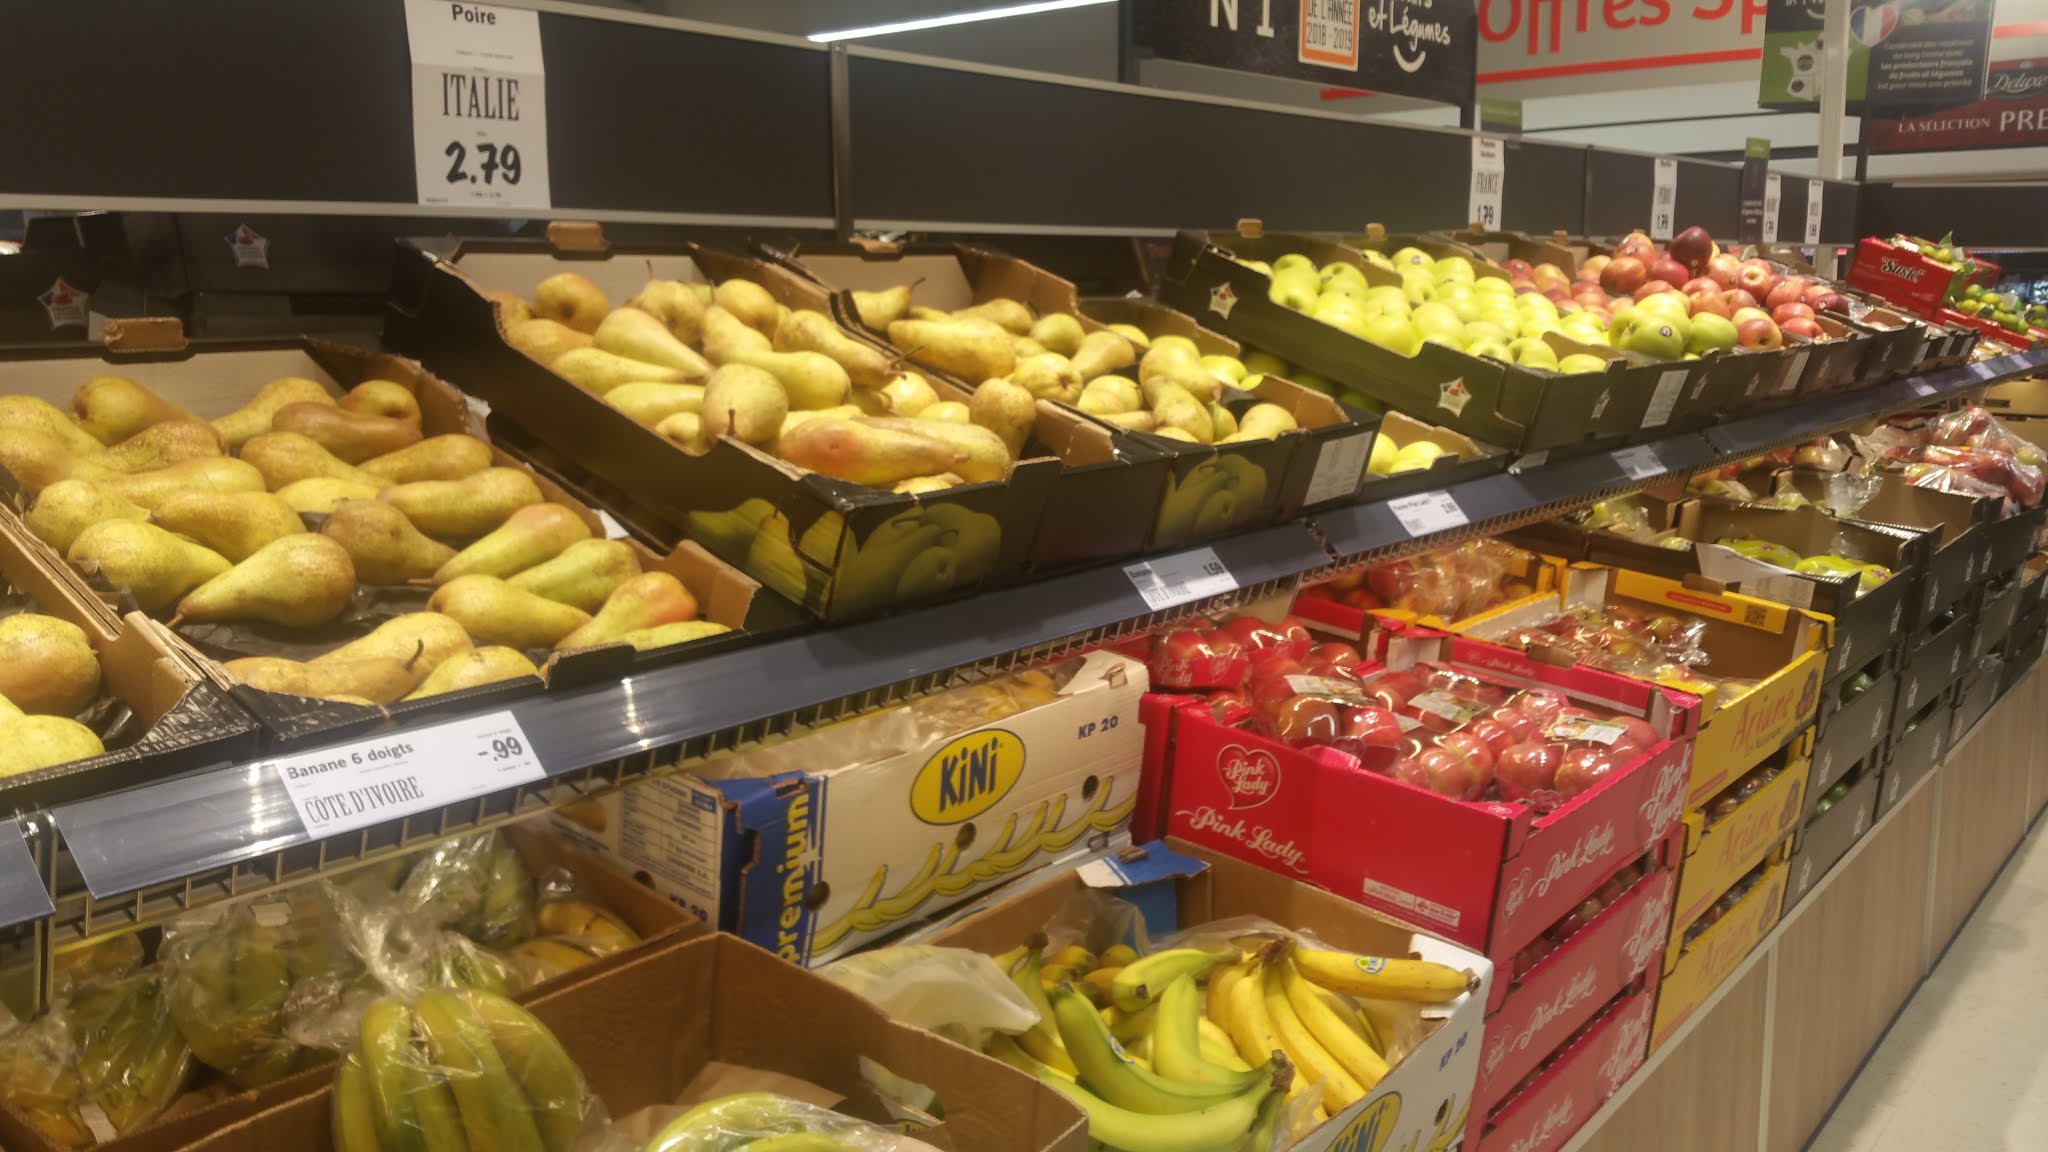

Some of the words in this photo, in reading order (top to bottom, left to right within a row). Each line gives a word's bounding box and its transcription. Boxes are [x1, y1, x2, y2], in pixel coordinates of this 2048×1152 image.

[451, 4, 496, 25] Poire
[1389, 0, 1451, 52] Légumes
[1307, 22, 1327, 47] 2018
[1333, 27, 1353, 51] 2019
[442, 72, 520, 121] ITALIE
[445, 140, 522, 185] 2.79
[1476, 171, 1499, 194] FRANCE
[1077, 722, 1096, 740] KP
[1100, 715, 1119, 732] 20
[287, 758, 347, 780] Banane
[351, 751, 363, 765] 6
[367, 741, 414, 763] doigts
[1222, 758, 1265, 780] Pink
[304, 789, 352, 824] CÔTE
[349, 776, 424, 813] D'IVOIRE
[1232, 776, 1271, 796] Lady
[1175, 805, 1248, 841] Pink
[1245, 825, 1310, 874] Lady
